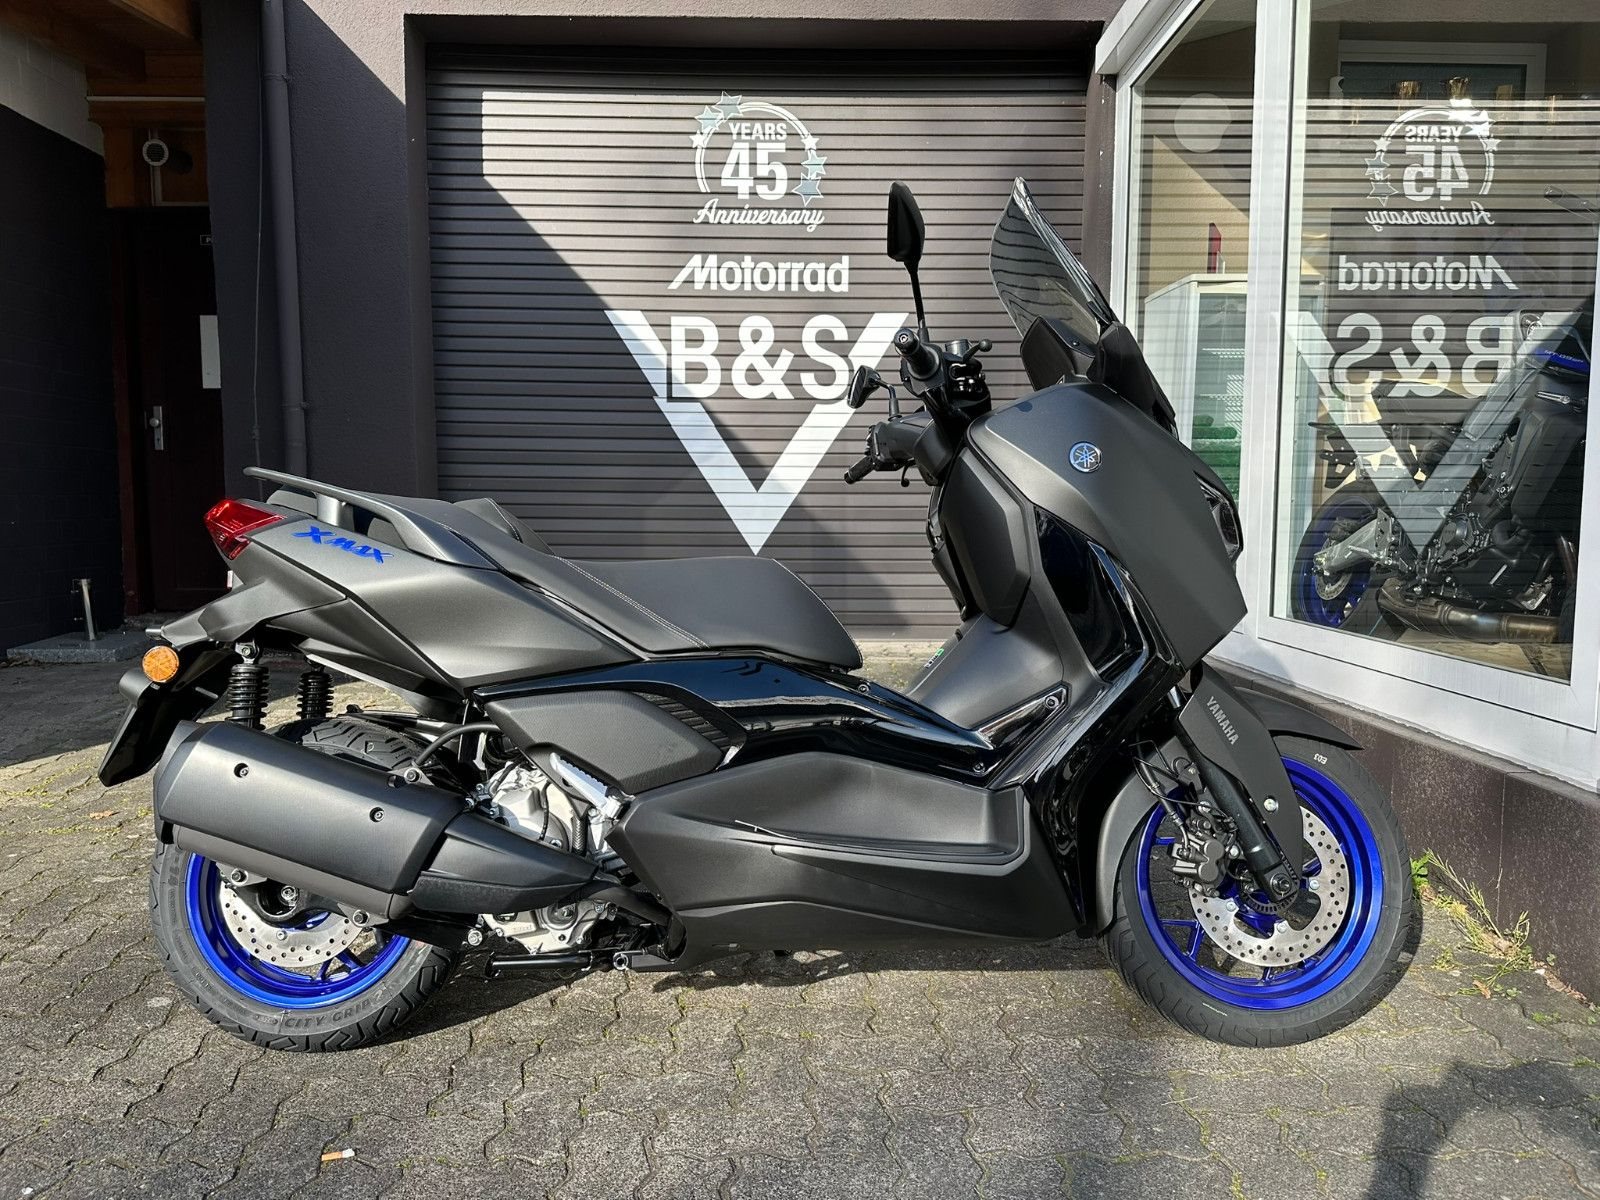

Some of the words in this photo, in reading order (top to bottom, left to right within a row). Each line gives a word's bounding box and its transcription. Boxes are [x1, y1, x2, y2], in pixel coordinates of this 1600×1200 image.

[729, 122, 787, 141] YEARS
[720, 142, 788, 201] 45
[693, 198, 825, 233] Anniversary
[667, 254, 849, 293] Motorrad
[670, 314, 850, 400] B&S
[1206, 695, 1239, 746] YAMAHA
[284, 1014, 326, 1028] CITY
[332, 1000, 371, 1022] GRIP
